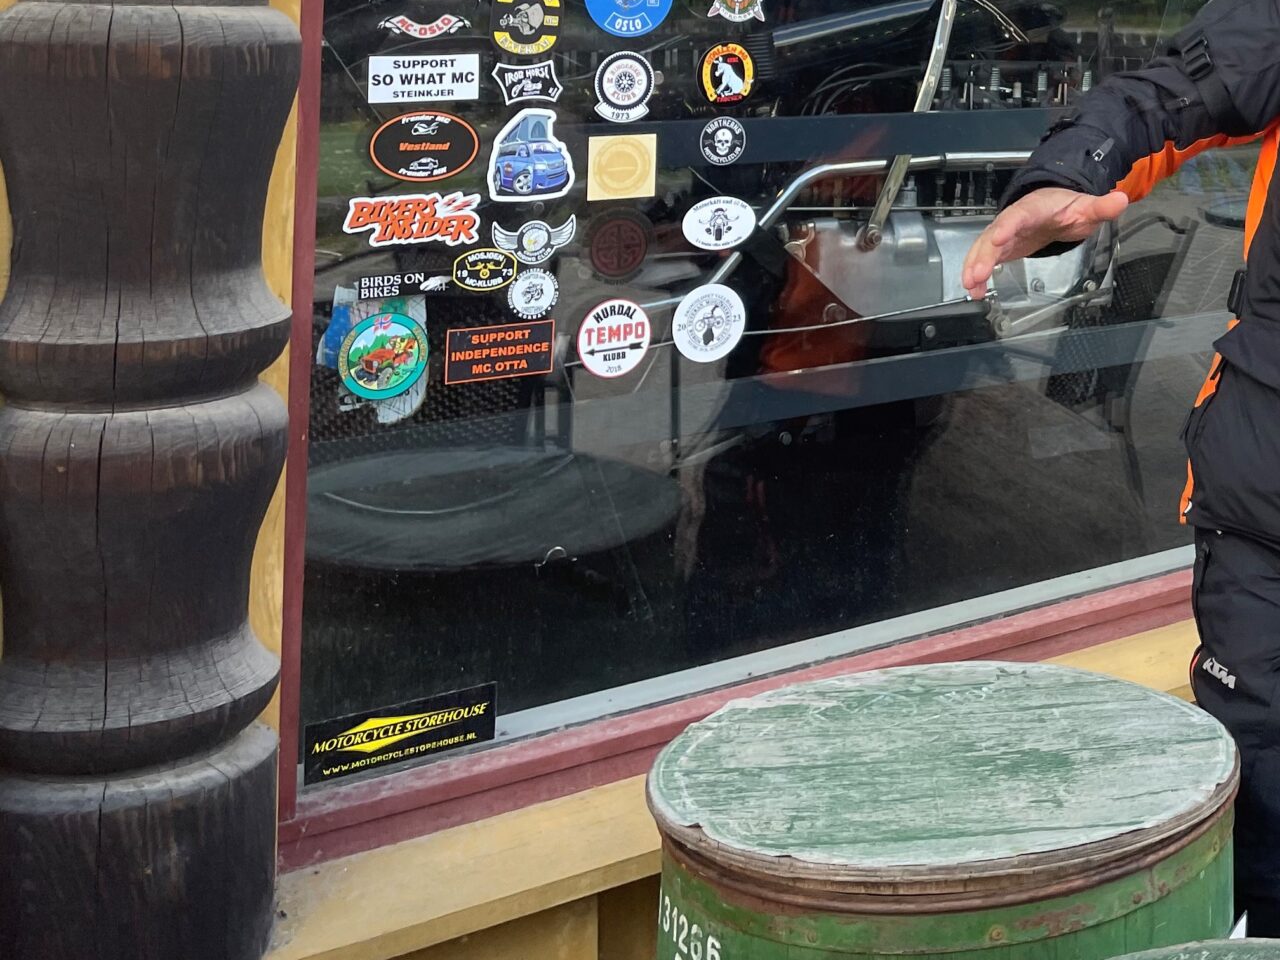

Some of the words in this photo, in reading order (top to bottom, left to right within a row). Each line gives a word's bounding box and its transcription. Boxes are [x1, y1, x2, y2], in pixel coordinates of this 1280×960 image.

[614, 18, 643, 32] OSLO
[392, 59, 457, 69] SUPPORT
[371, 74, 394, 87] SO
[399, 72, 447, 86] WHAT
[451, 71, 476, 84] MC
[392, 88, 455, 99] STEINKJER
[611, 111, 630, 120] 1973
[348, 195, 438, 229] BIKERS
[374, 215, 476, 243] INSIDER
[457, 270, 468, 278] 19
[502, 268, 513, 276] 73
[361, 274, 402, 288] BIRDS
[404, 273, 425, 285] ON
[361, 287, 400, 299] BIKES
[593, 304, 638, 324] HURDAL
[471, 329, 531, 345] SUPPORT
[584, 321, 645, 346] TEMPO
[451, 341, 550, 362] INDEPENDENCE
[603, 351, 626, 362] KLUBB
[472, 362, 492, 374] MC
[494, 359, 528, 372] OTTA
[1202, 656, 1236, 690] KTM
[312, 722, 403, 755] MOTORCYCLE
[404, 702, 489, 734] STOREHOUSE
